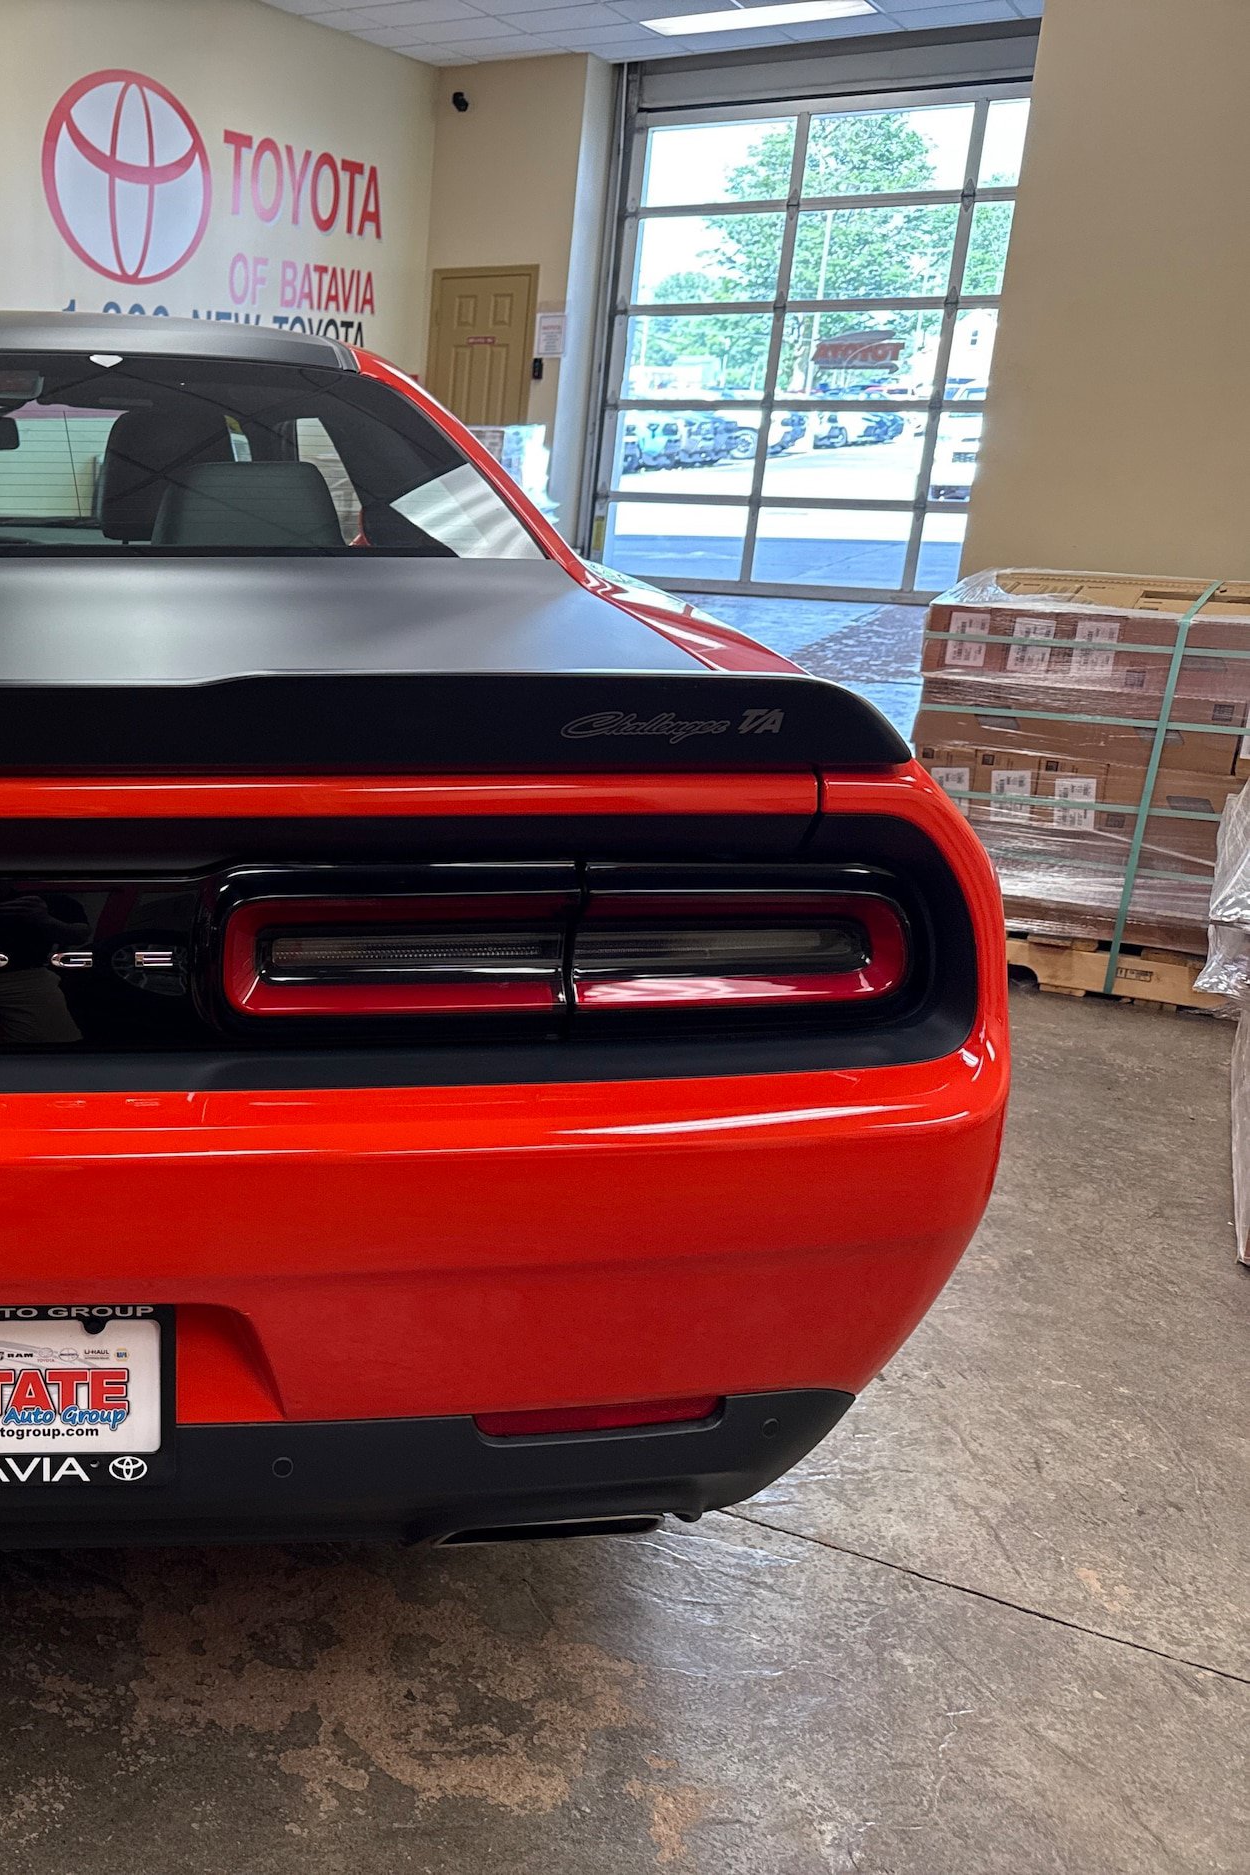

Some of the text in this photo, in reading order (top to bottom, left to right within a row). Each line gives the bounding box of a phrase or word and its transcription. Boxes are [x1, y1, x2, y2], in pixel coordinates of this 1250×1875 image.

[223, 128, 382, 240] TOYOTA
[228, 253, 375, 315] OF BATAVIA
[561, 711, 730, 744] Challenger
[47, 1306, 154, 1317] GROUP
[2, 1405, 127, 1432] Auto Group
